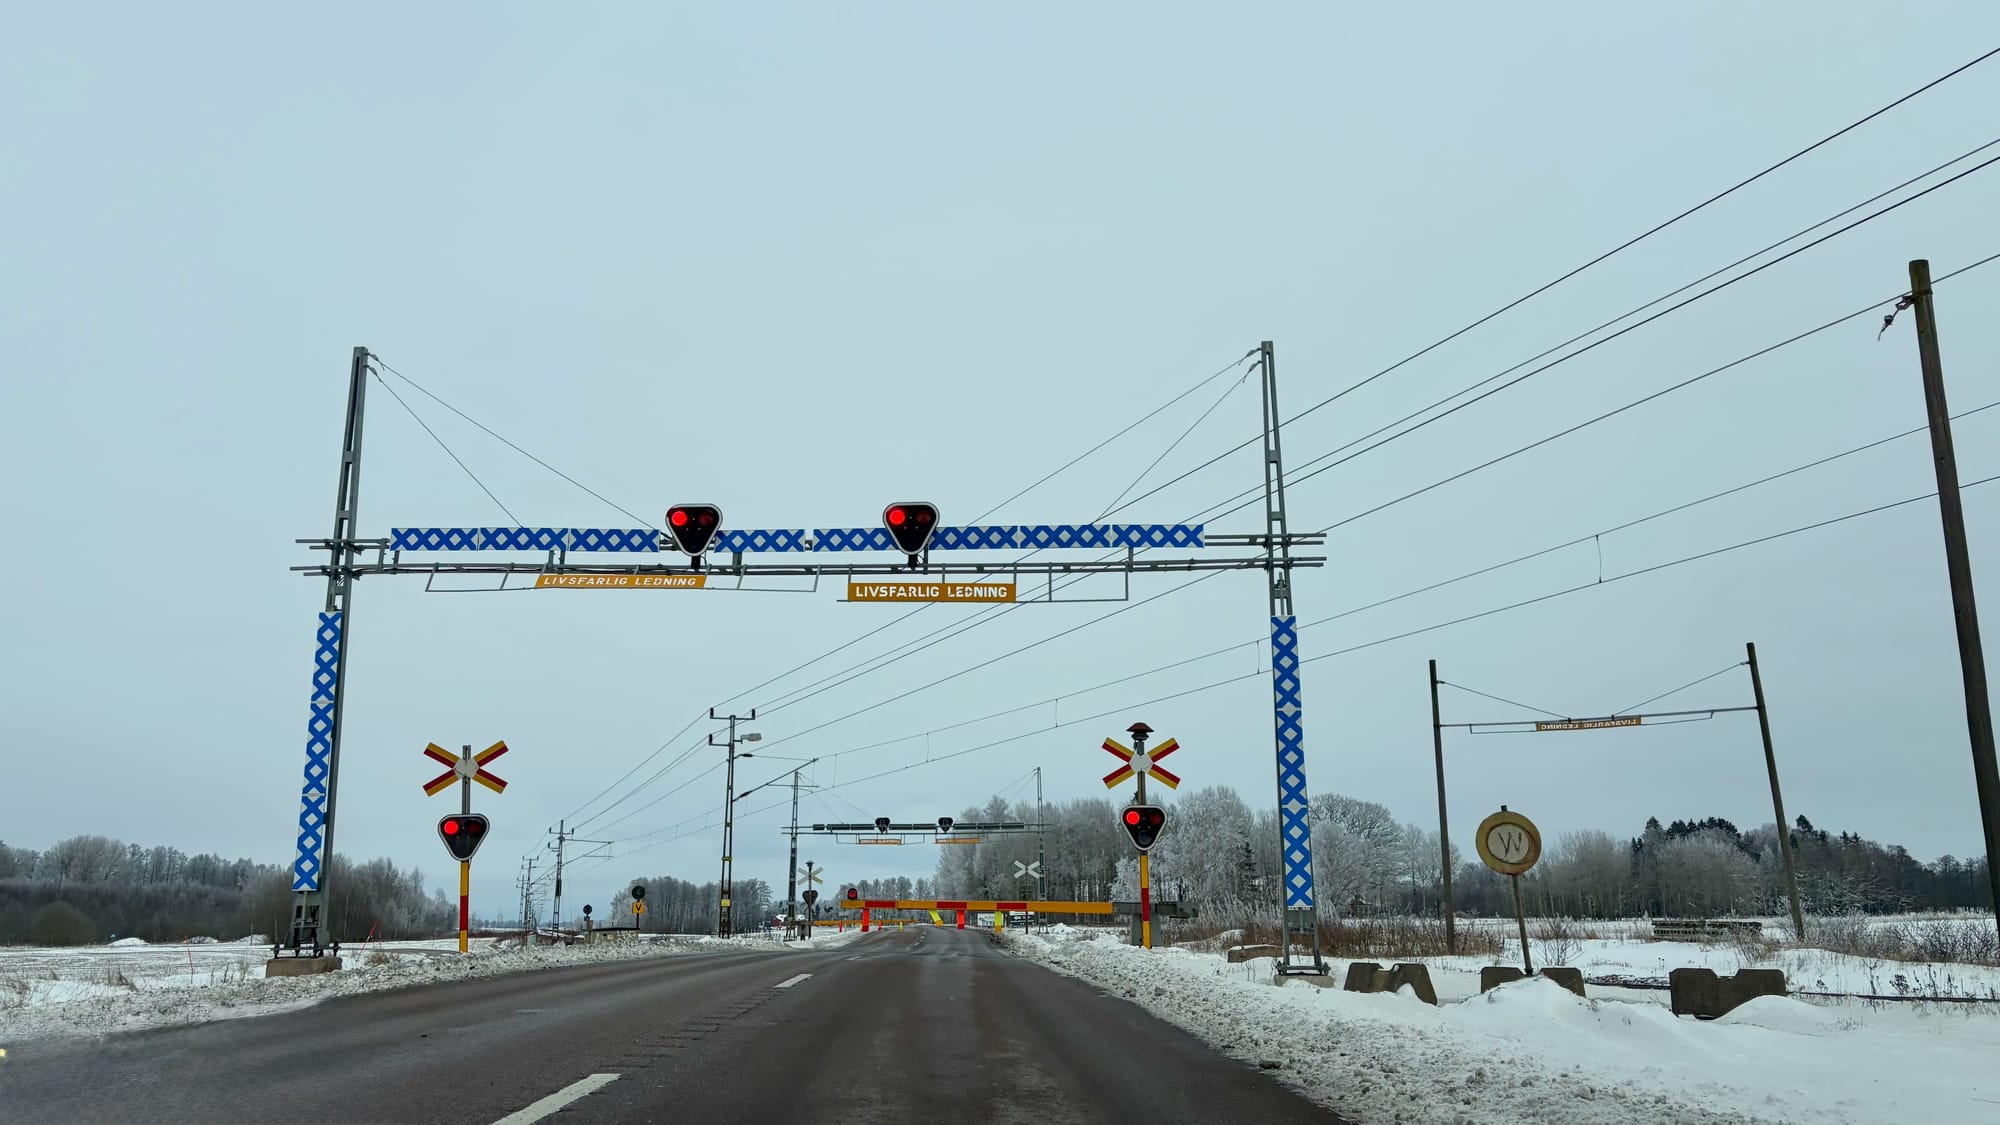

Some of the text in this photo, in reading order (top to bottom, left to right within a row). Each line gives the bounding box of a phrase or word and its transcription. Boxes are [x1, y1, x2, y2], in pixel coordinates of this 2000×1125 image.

[543, 577, 697, 586] LIVSFARLIG LEDNING
[856, 586, 1008, 598] LIVSFARLIG LEDNING
[635, 903, 642, 911] V
